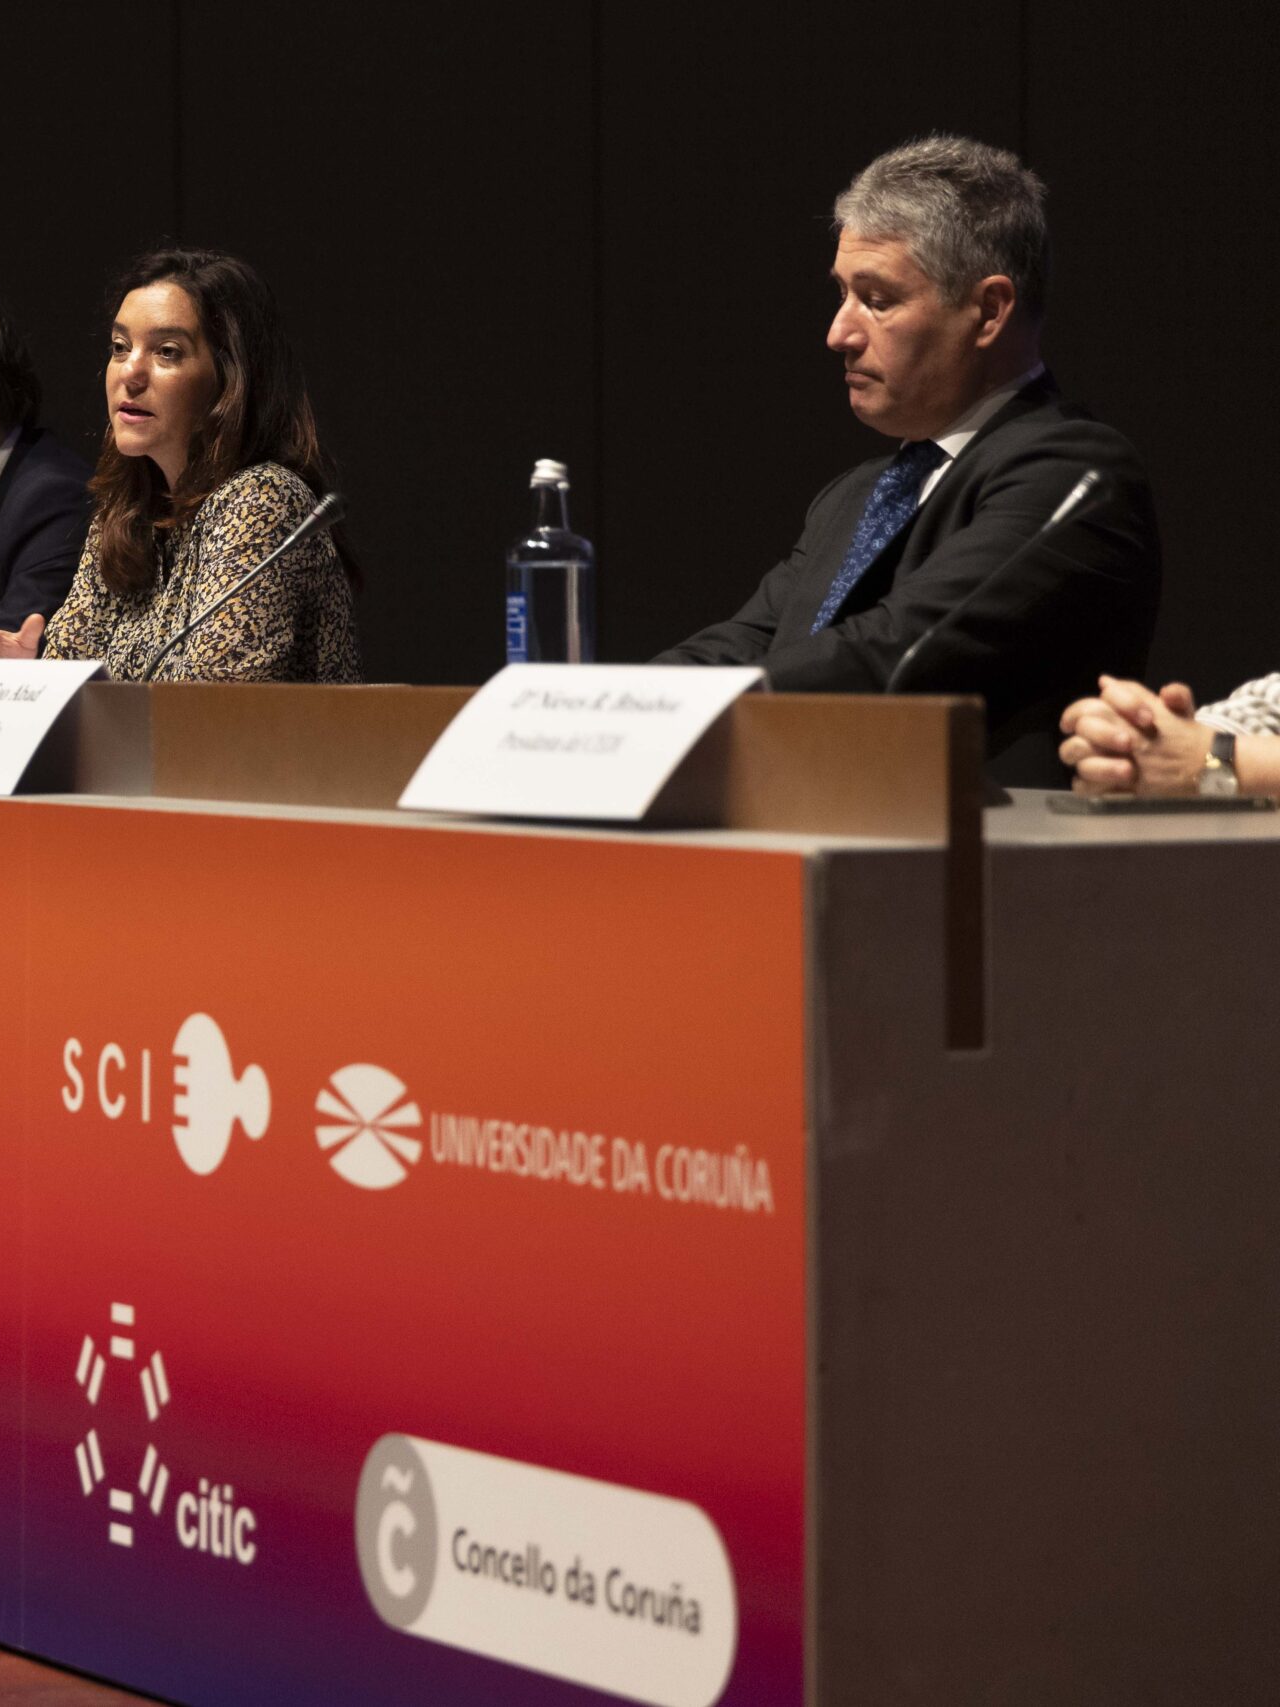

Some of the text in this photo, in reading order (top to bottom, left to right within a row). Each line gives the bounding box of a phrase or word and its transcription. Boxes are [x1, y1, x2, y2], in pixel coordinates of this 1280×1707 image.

[430, 1112, 775, 1215] UNIVERSIDADE DA CORUÑA
[174, 1478, 257, 1566] citic
[452, 1527, 701, 1635] Concello da Coruña
